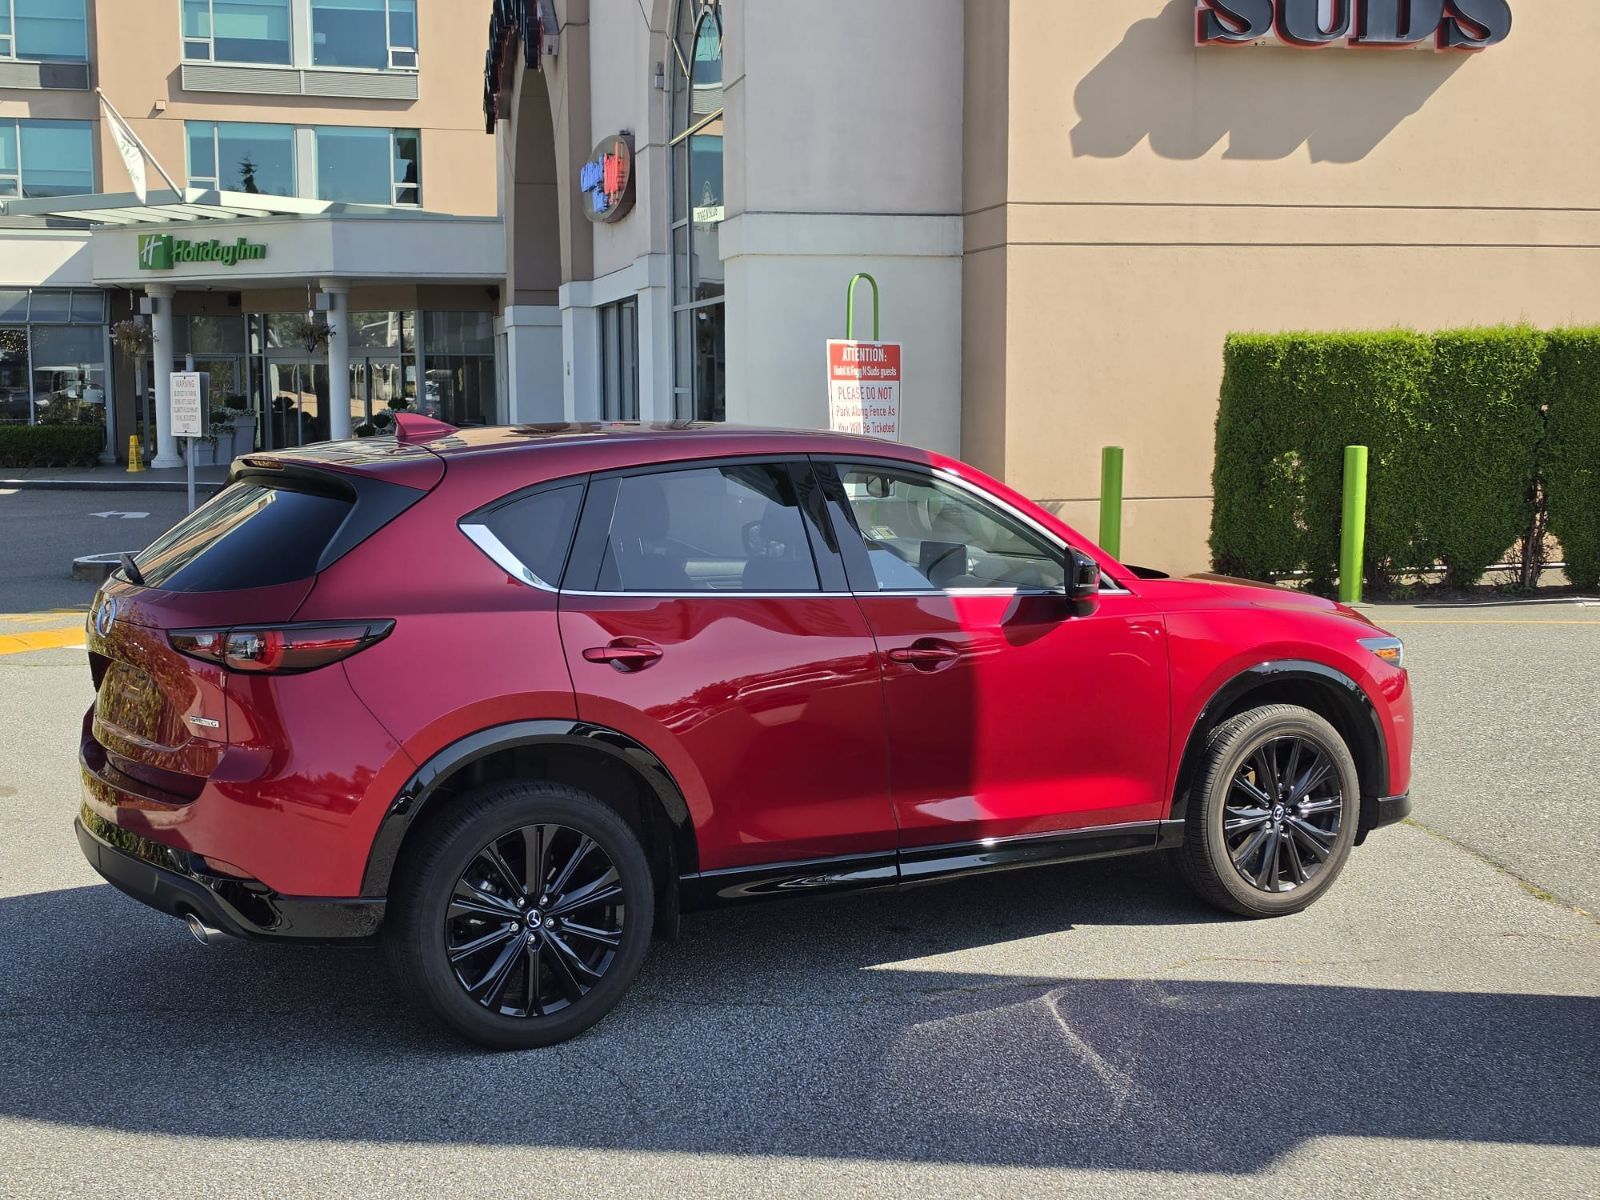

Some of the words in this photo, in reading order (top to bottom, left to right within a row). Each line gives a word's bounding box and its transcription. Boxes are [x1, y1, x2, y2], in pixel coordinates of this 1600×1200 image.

[172, 239, 238, 266] Holiday
[842, 347, 887, 362] ATTENTION:
[867, 366, 880, 376] Suds
[880, 366, 897, 379] guests
[837, 386, 865, 400] PLEASE
[866, 386, 876, 400] DO
[877, 386, 893, 400] NOT
[836, 404, 851, 417] Park
[851, 404, 868, 419] Along
[869, 405, 886, 417] Fence
[887, 405, 896, 417] As
[863, 421, 870, 433] Be
[871, 421, 896, 433] Ticketed
